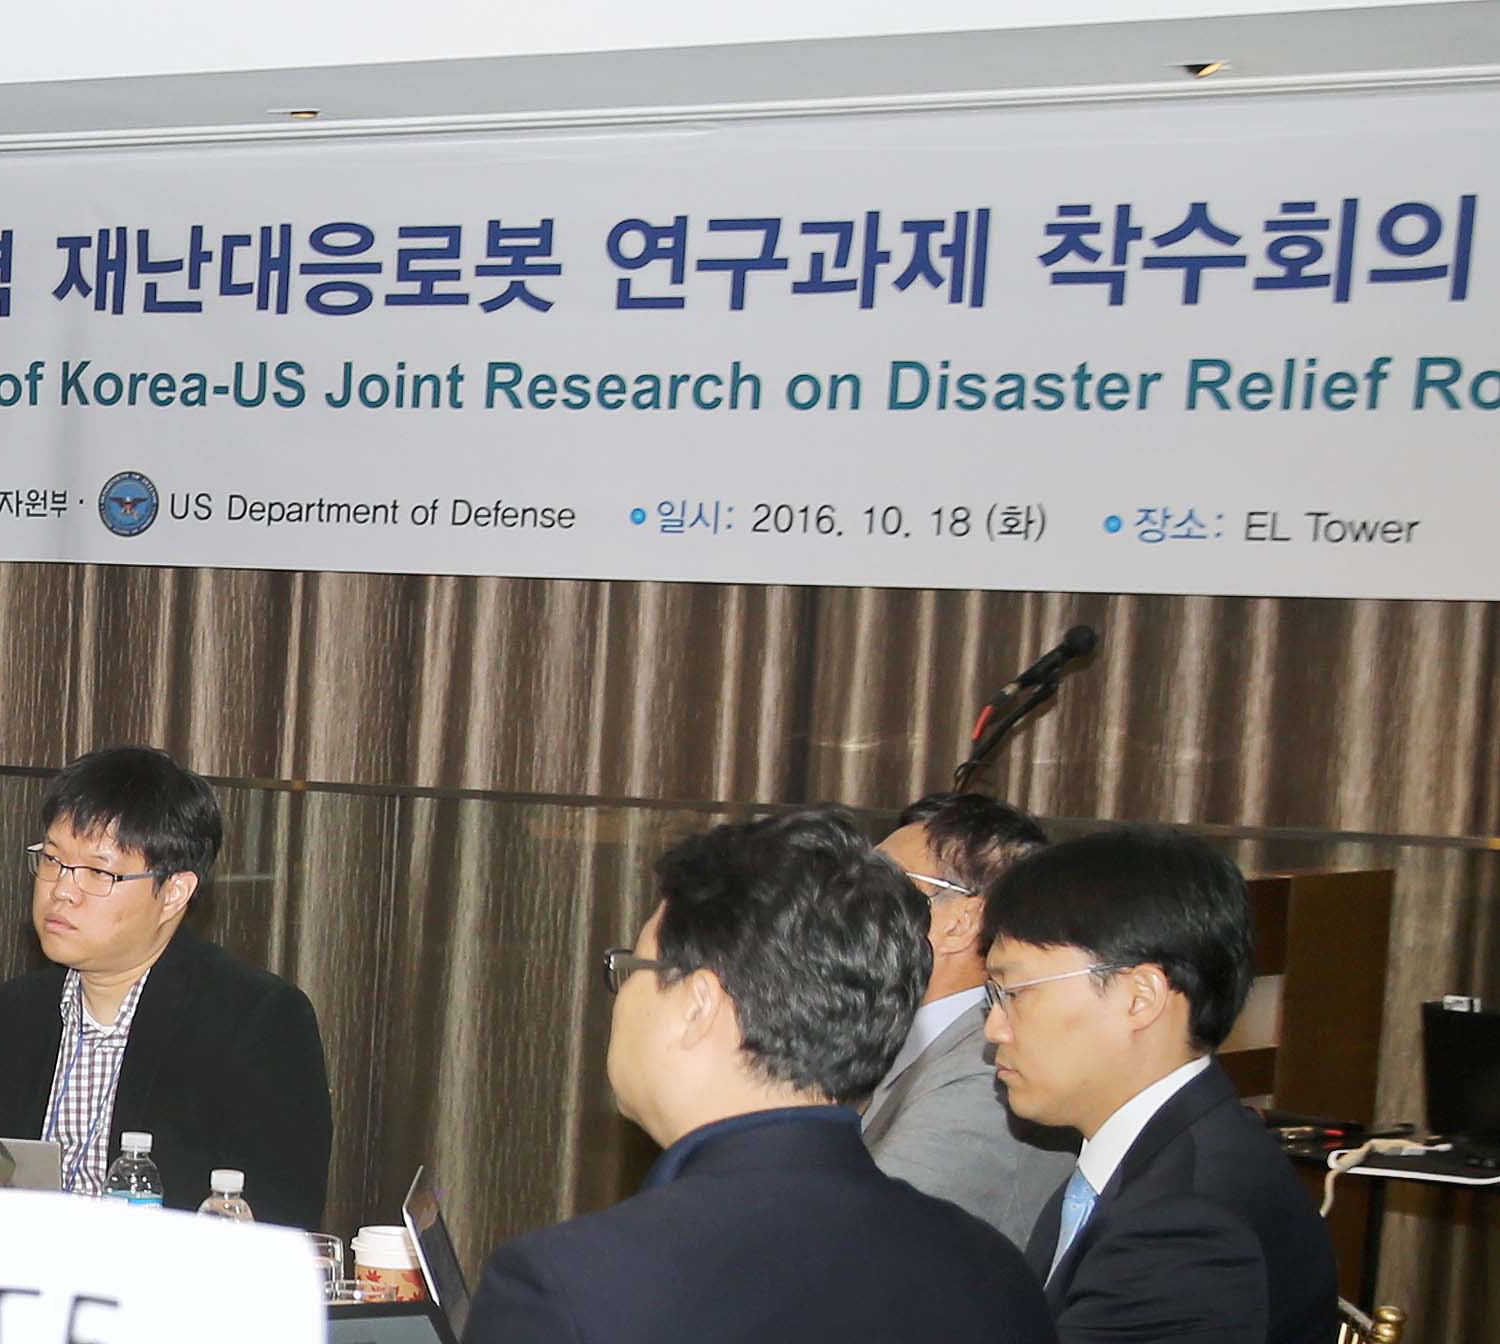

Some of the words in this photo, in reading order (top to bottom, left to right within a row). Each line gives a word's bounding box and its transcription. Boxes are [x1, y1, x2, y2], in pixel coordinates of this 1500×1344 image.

[52, 217, 563, 316] 재난대응로봇
[606, 207, 992, 311] 연구과제
[1037, 193, 1479, 306] 착수회의
[61, 359, 306, 409] Korea-US
[325, 361, 465, 410] Joint
[485, 361, 763, 411] Research
[786, 374, 863, 411] on
[887, 359, 1165, 412] Disaster
[1185, 355, 1393, 412] Relief
[170, 493, 213, 520] US
[228, 494, 400, 527] Department
[410, 498, 440, 526] of
[451, 498, 576, 530] Defense
[656, 499, 734, 535] 일시:
[751, 504, 844, 538] 2016.
[863, 506, 912, 539] 10.
[931, 506, 972, 538] 18
[987, 504, 1047, 543] (화)
[1135, 507, 1225, 544] 장소:
[1244, 511, 1292, 542] EL
[1303, 511, 1421, 544] Tower
